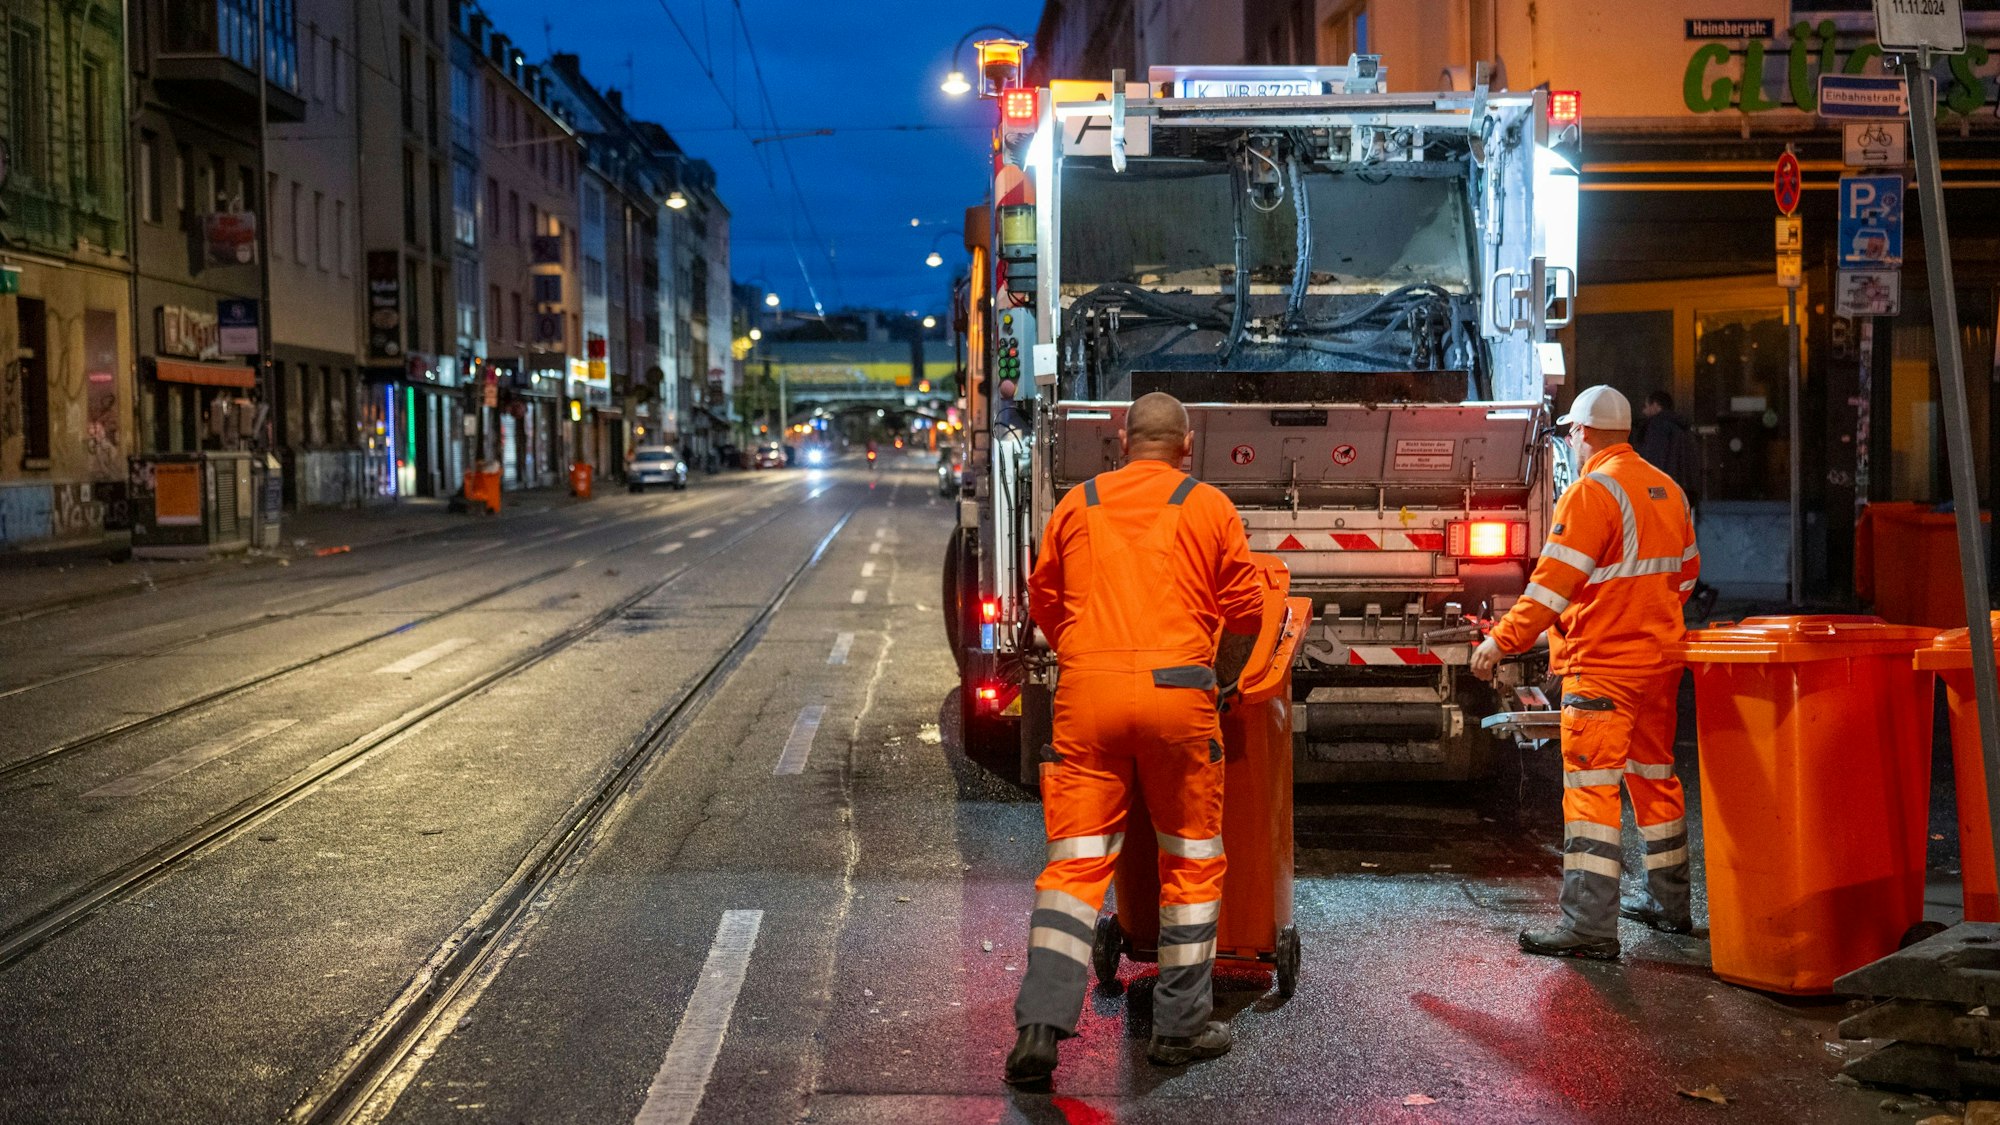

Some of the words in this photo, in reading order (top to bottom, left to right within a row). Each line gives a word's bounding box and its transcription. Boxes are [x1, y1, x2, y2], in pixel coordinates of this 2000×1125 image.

[1893, 0, 1945, 15] 11.11.2024
[1692, 20, 1767, 37] Heinsbergstr.
[1683, 20, 1989, 121] GLÜS
[1198, 84, 1209, 98] K
[1225, 84, 1250, 98] WB
[1825, 91, 1901, 103] Einbahnstraße
[1849, 182, 1877, 219] P
